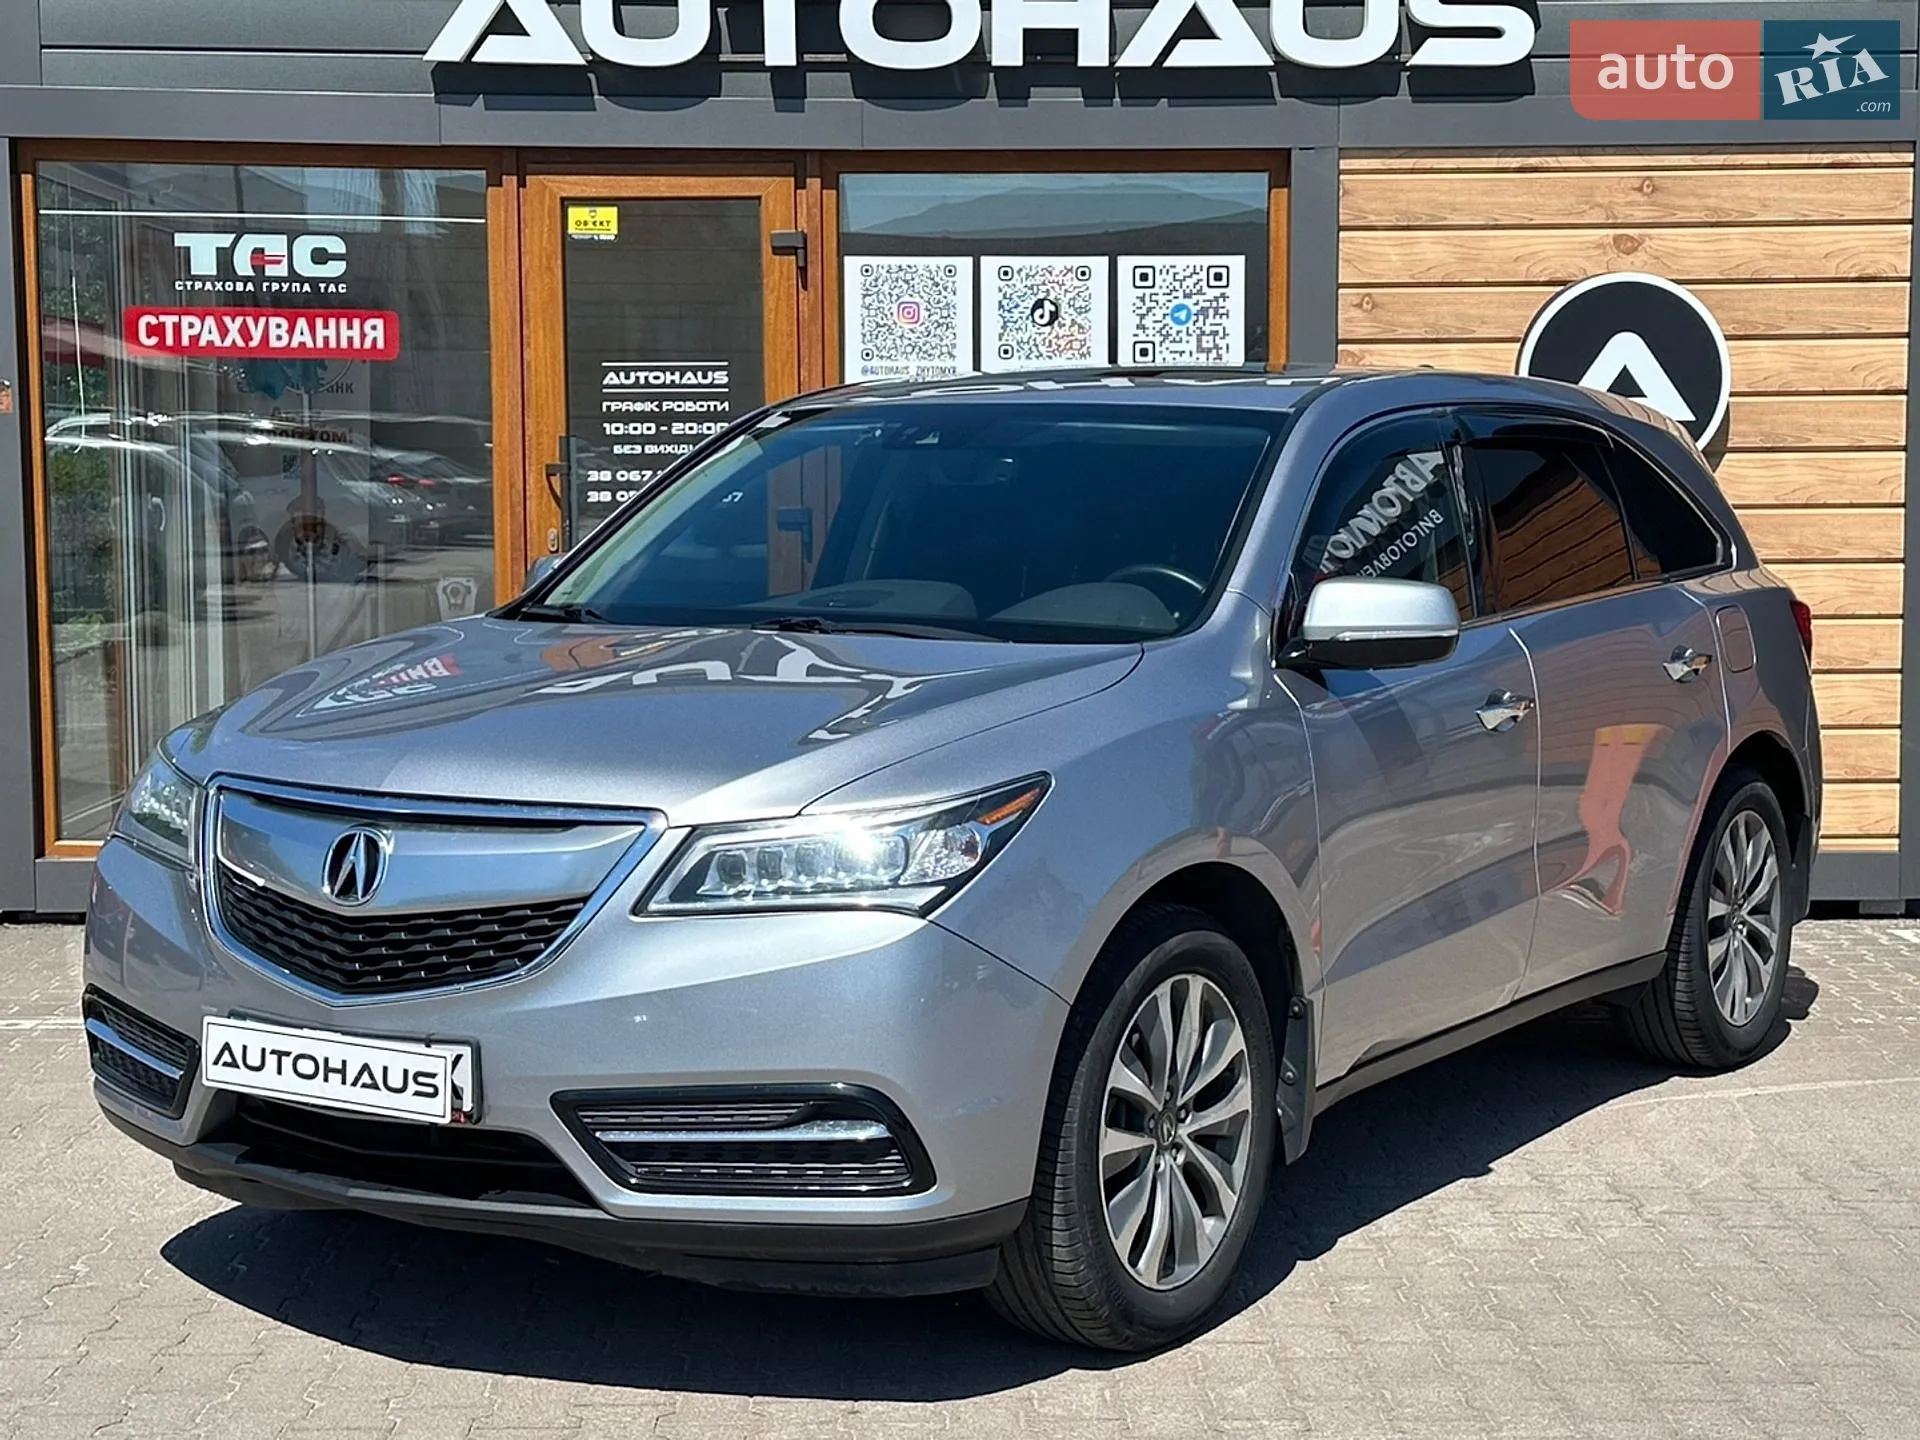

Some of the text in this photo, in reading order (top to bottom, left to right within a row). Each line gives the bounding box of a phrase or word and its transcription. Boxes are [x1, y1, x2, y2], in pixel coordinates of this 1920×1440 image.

[174, 233, 347, 278] ТАС
[174, 280, 348, 294] СТРАХОВА ГРУПА ТАС
[137, 314, 385, 350] СТРАХУВАННЯ
[602, 370, 729, 385] AUTOHAUS
[602, 401, 729, 412] ГРАФІК РОБОТИ
[602, 422, 656, 435] 10:00
[613, 444, 642, 454] БЕЗ
[616, 470, 653, 482] 067
[211, 1041, 440, 1098] AUTOHAUS
